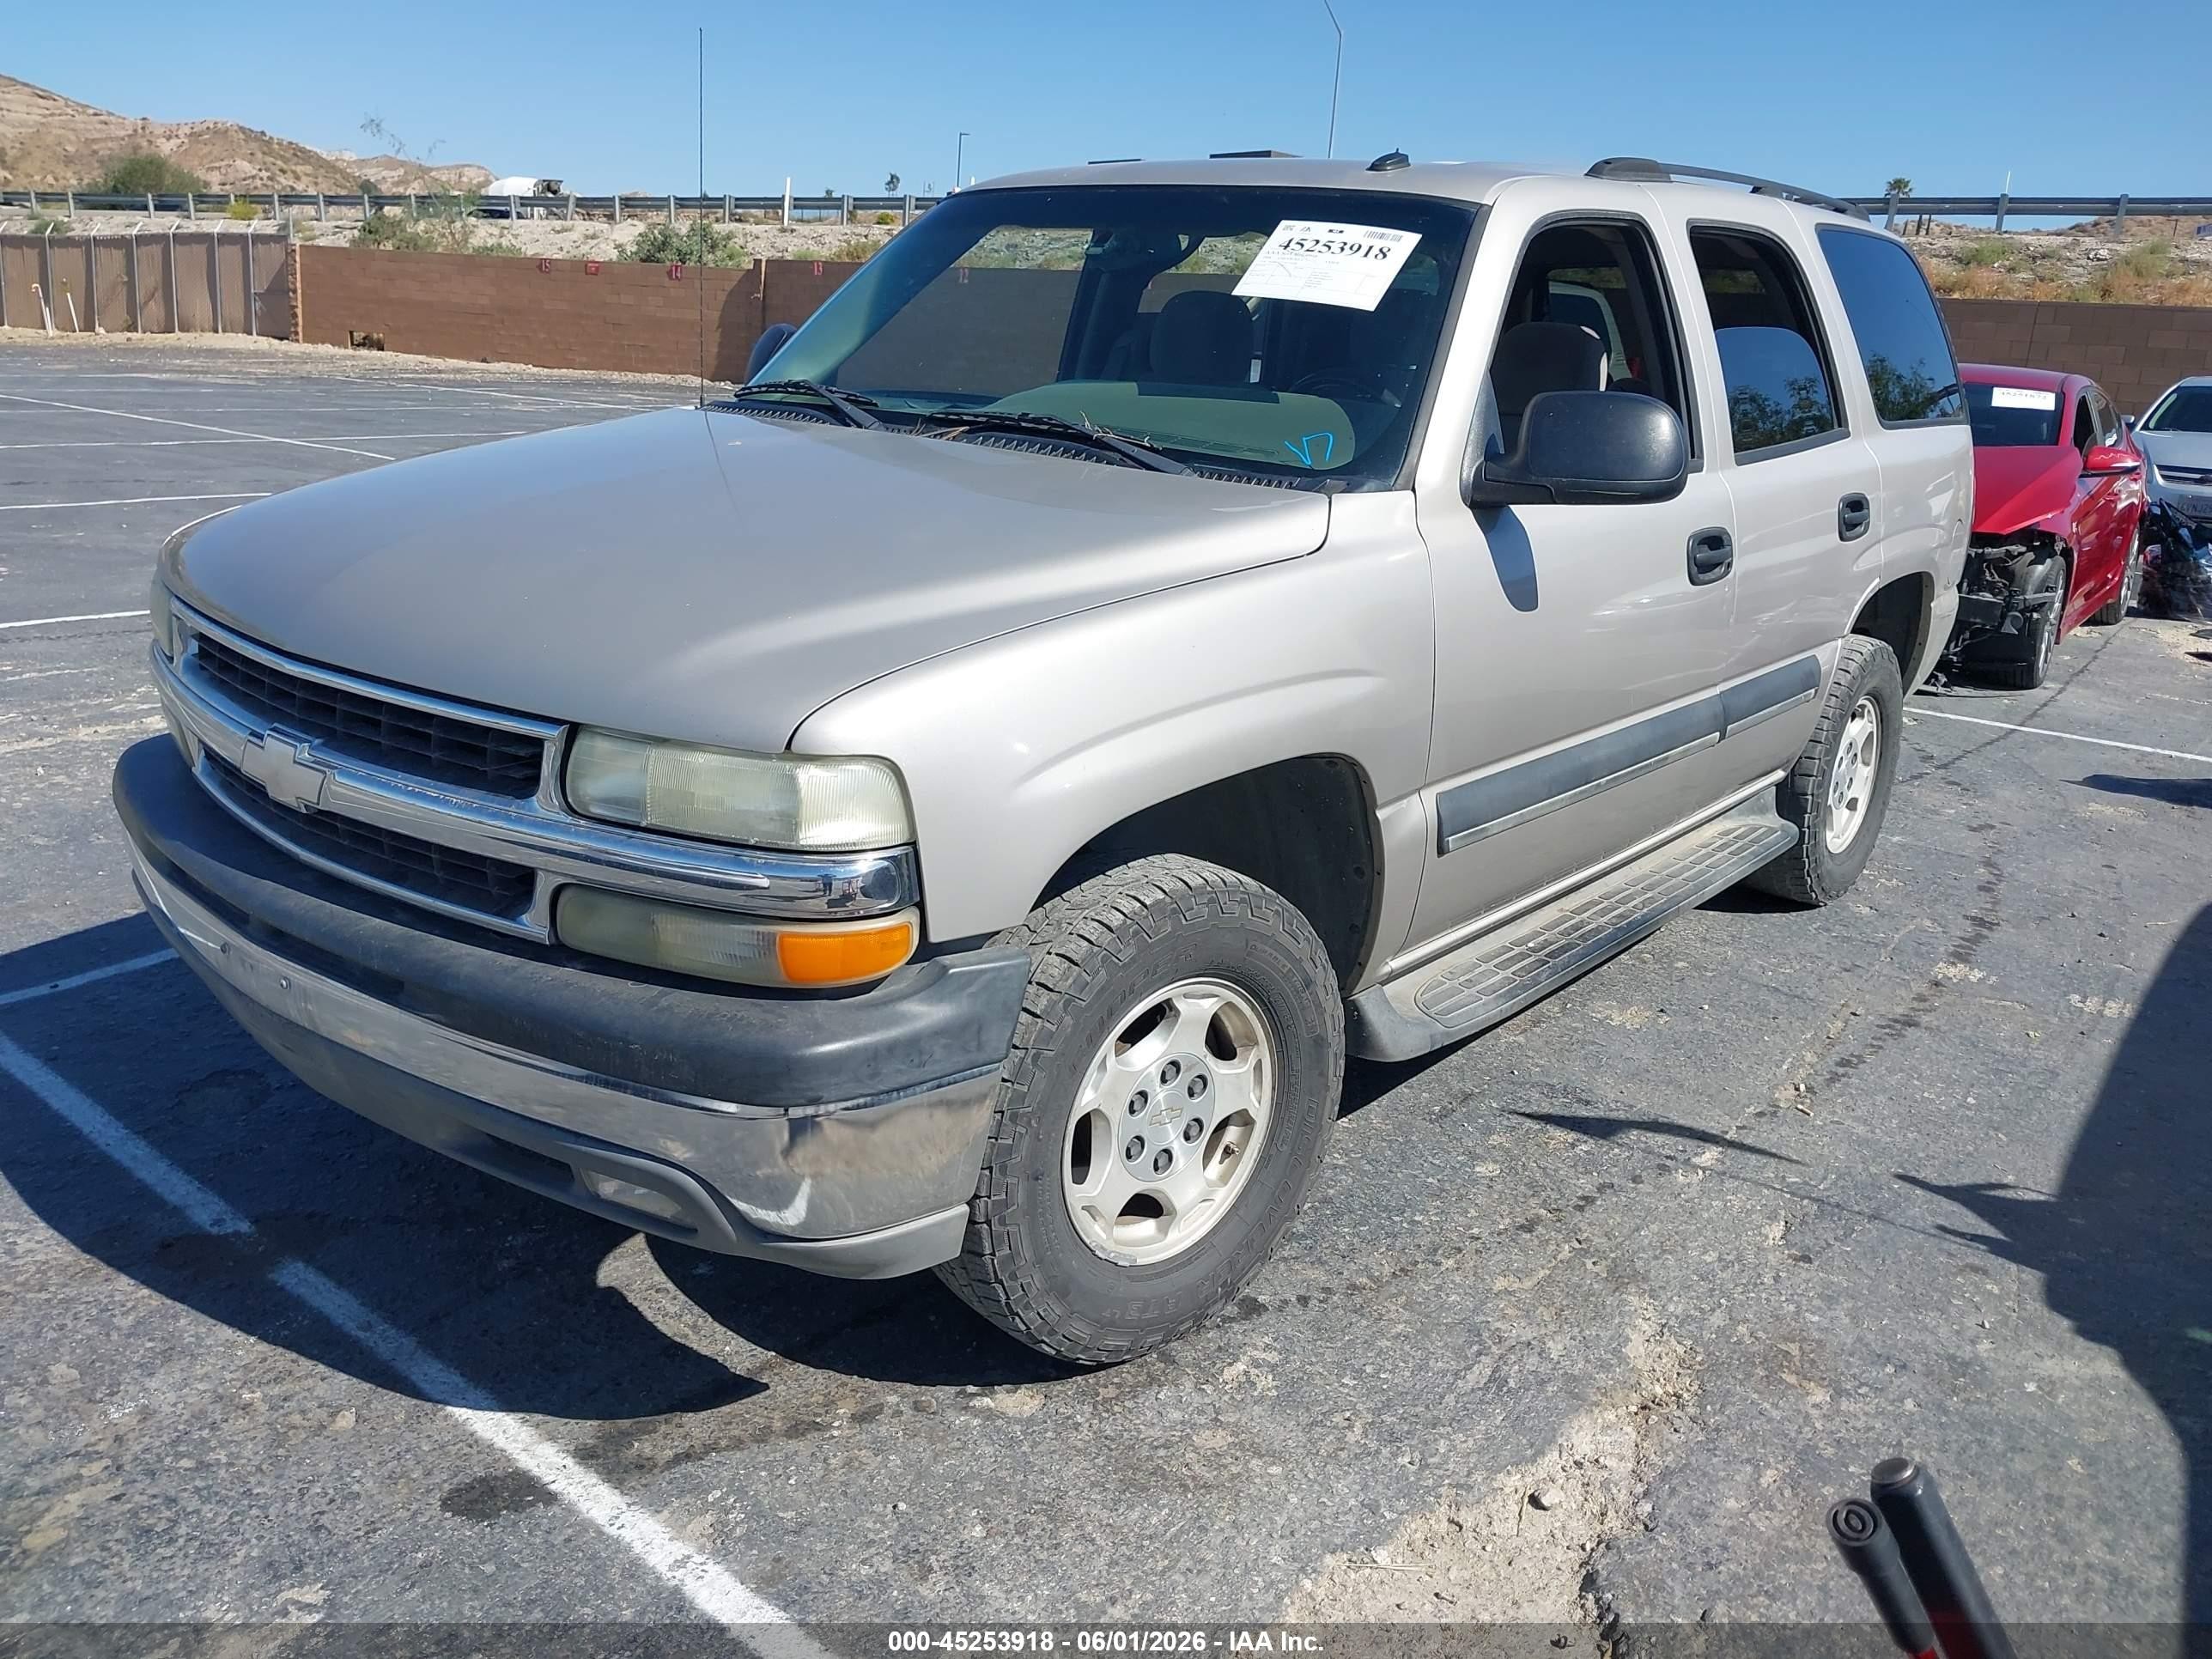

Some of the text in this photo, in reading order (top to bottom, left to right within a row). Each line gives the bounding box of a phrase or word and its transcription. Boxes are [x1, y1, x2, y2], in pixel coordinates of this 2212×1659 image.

[1279, 237, 1391, 260] 45253918
[542, 259, 550, 271] 15
[814, 262, 823, 275] 13
[672, 266, 681, 279] 14
